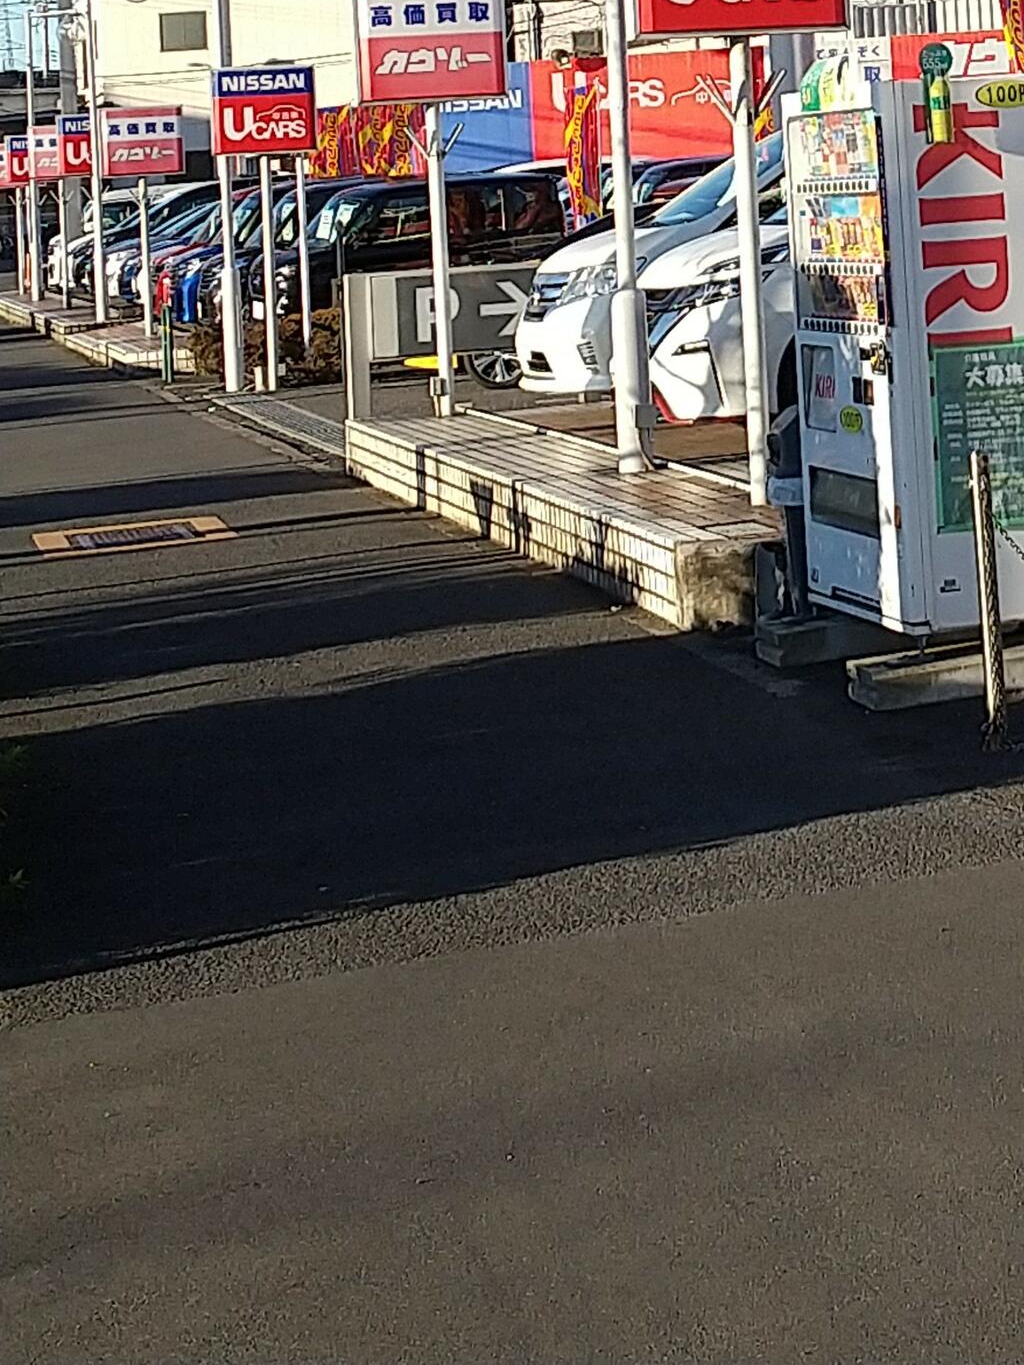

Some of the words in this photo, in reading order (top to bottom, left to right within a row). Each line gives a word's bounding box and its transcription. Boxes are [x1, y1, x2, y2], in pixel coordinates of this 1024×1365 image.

[370, 1, 491, 28] 高価買取
[221, 73, 305, 92] NISSAN
[415, 287, 460, 343] P
[964, 363, 1024, 389] 大募集
